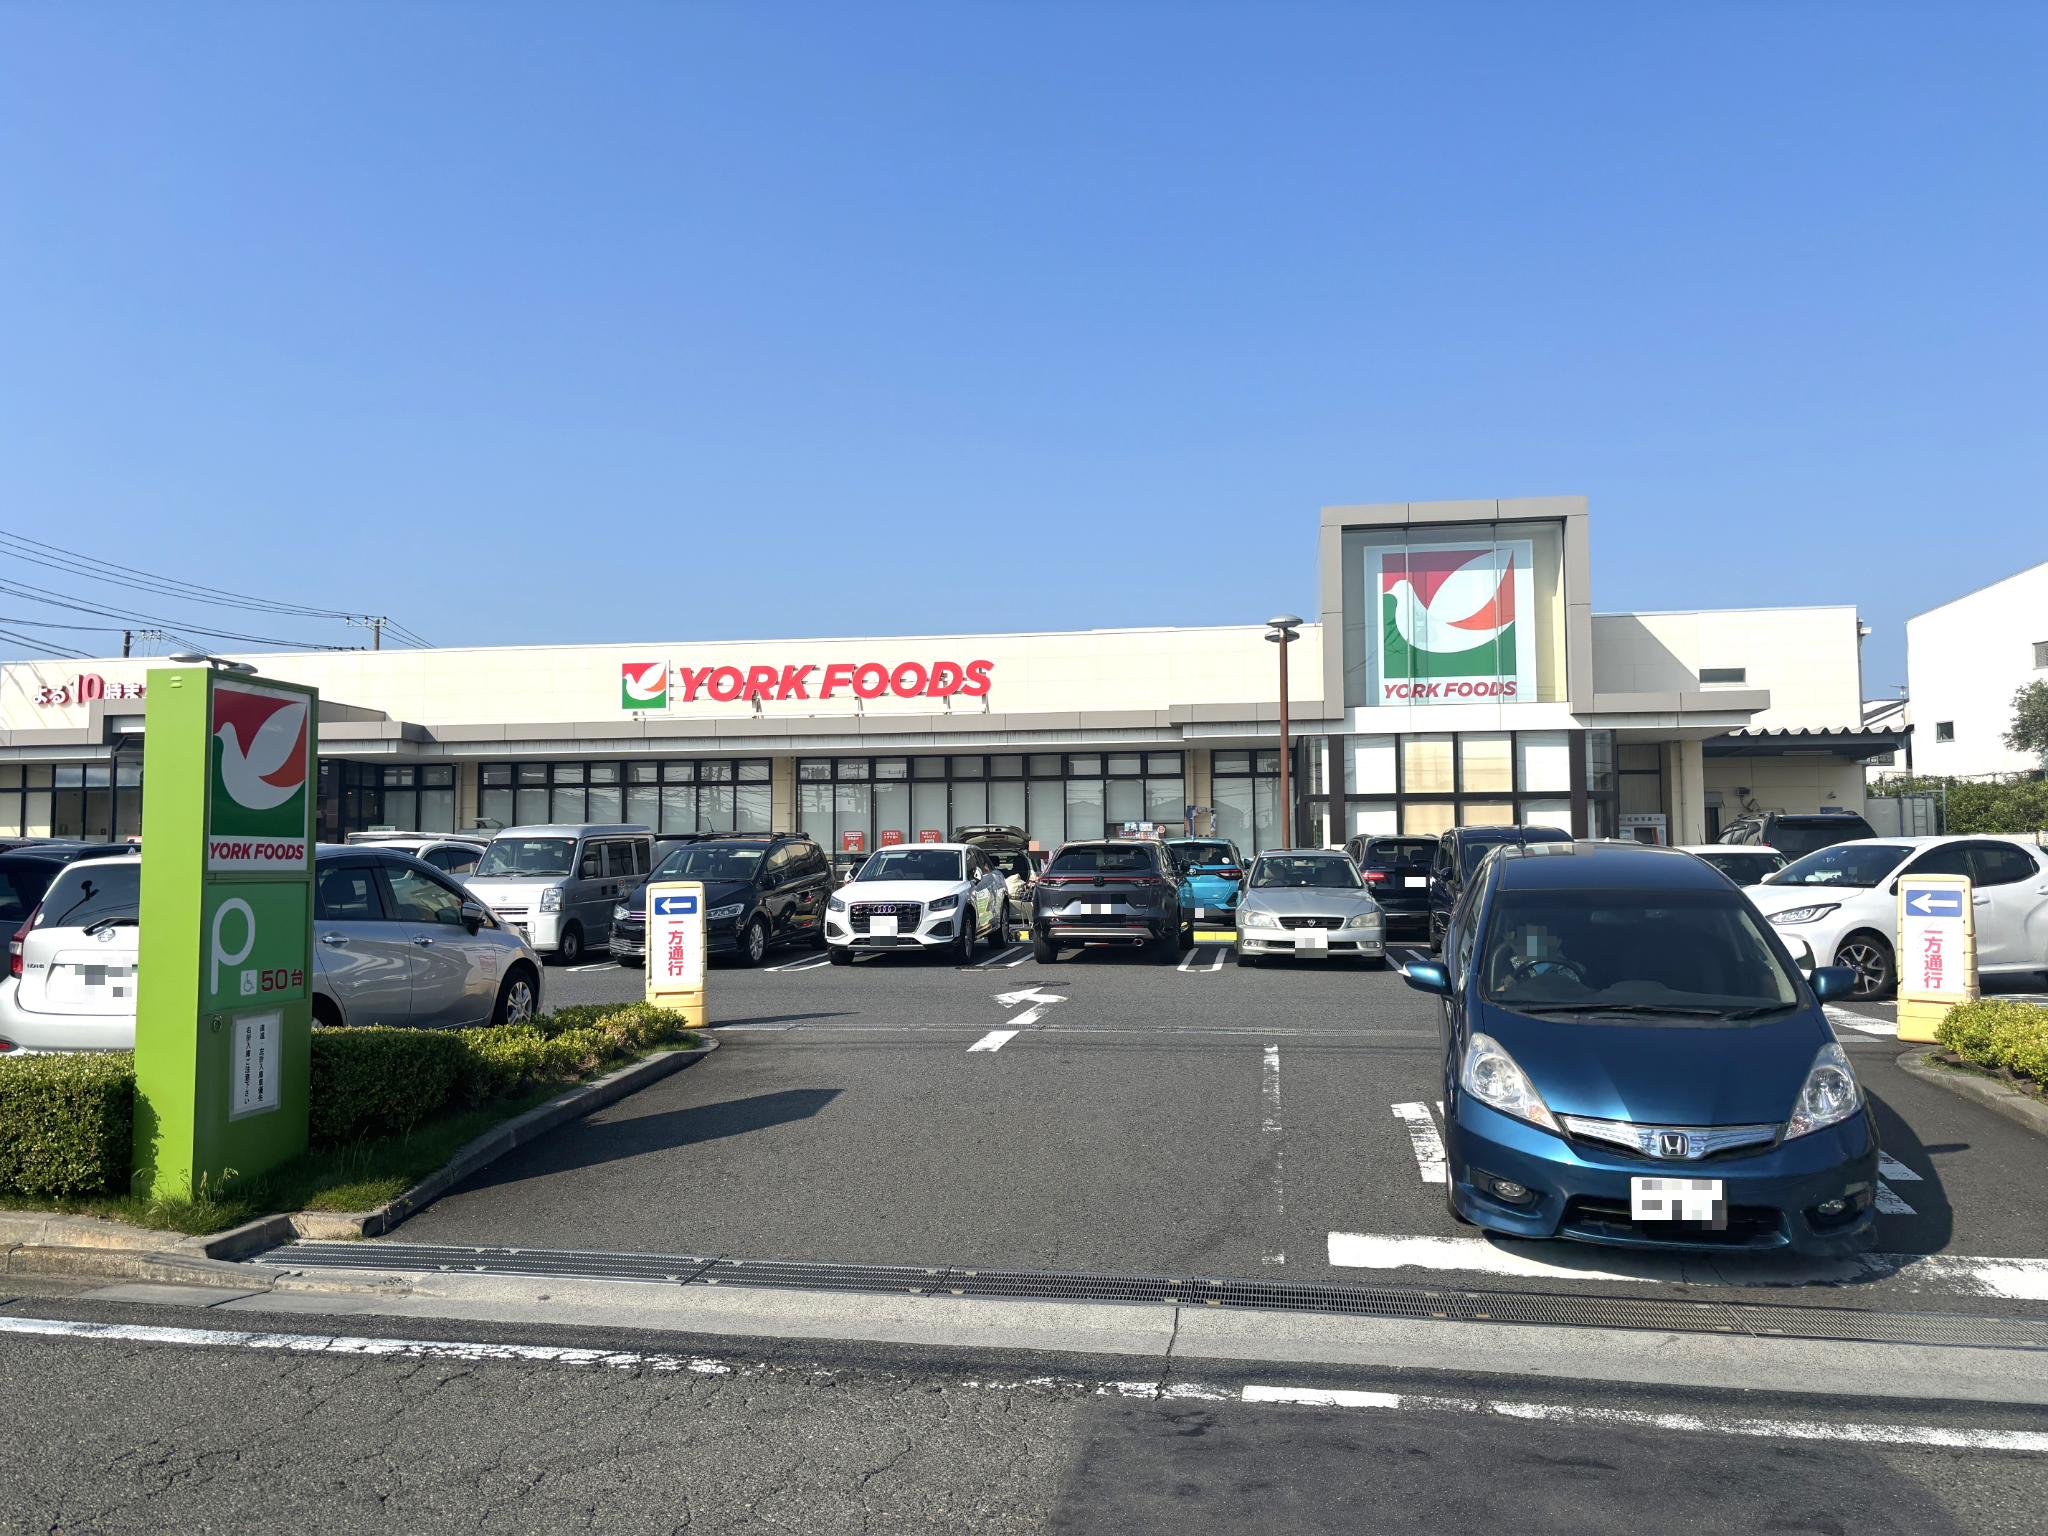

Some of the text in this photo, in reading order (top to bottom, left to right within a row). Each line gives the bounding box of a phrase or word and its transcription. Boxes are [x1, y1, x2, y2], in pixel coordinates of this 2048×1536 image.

[32, 673, 147, 704] よる10時ま
[679, 659, 995, 703] YORK FOODS
[1384, 681, 1517, 699] YORK FOODS
[209, 842, 305, 860] YORK FOODS
[667, 920, 684, 976] 一方通行
[1923, 929, 1943, 989] 一方通行
[261, 968, 304, 992] 50台
